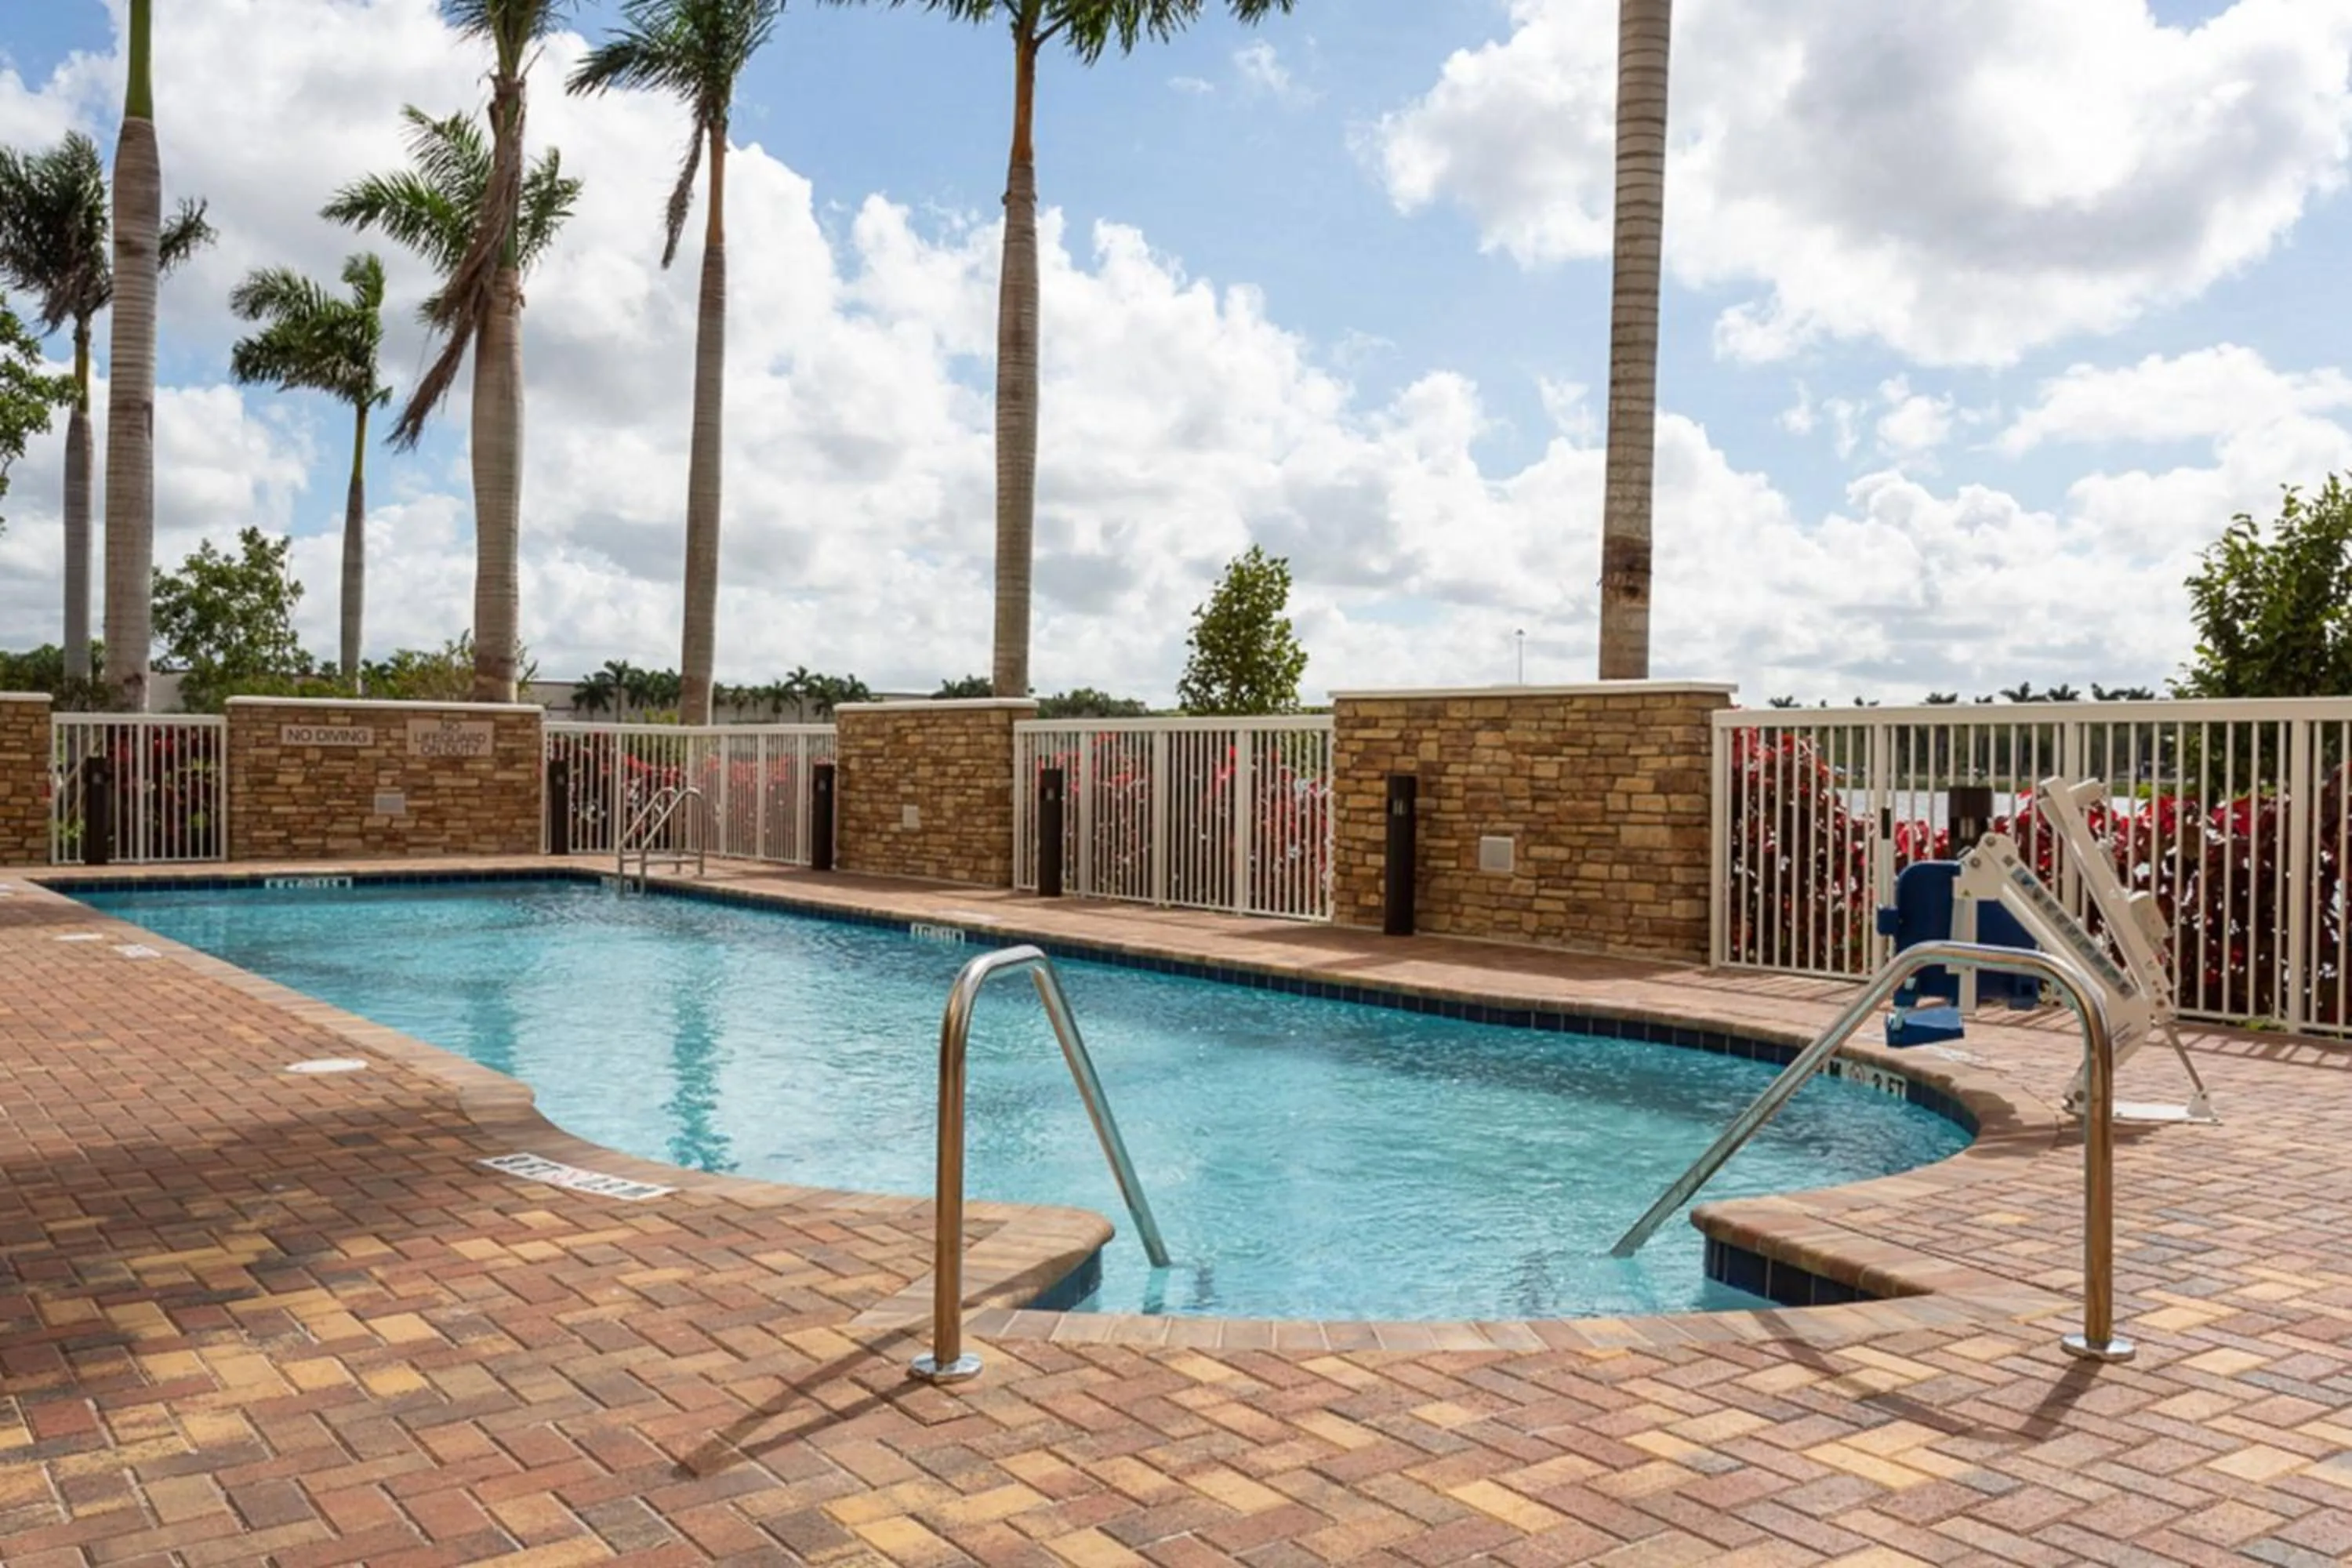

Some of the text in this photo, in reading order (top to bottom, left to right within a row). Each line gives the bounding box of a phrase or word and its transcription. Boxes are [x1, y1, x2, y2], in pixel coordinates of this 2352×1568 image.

[441, 720, 462, 731] NO
[287, 728, 368, 743] NO DIVING
